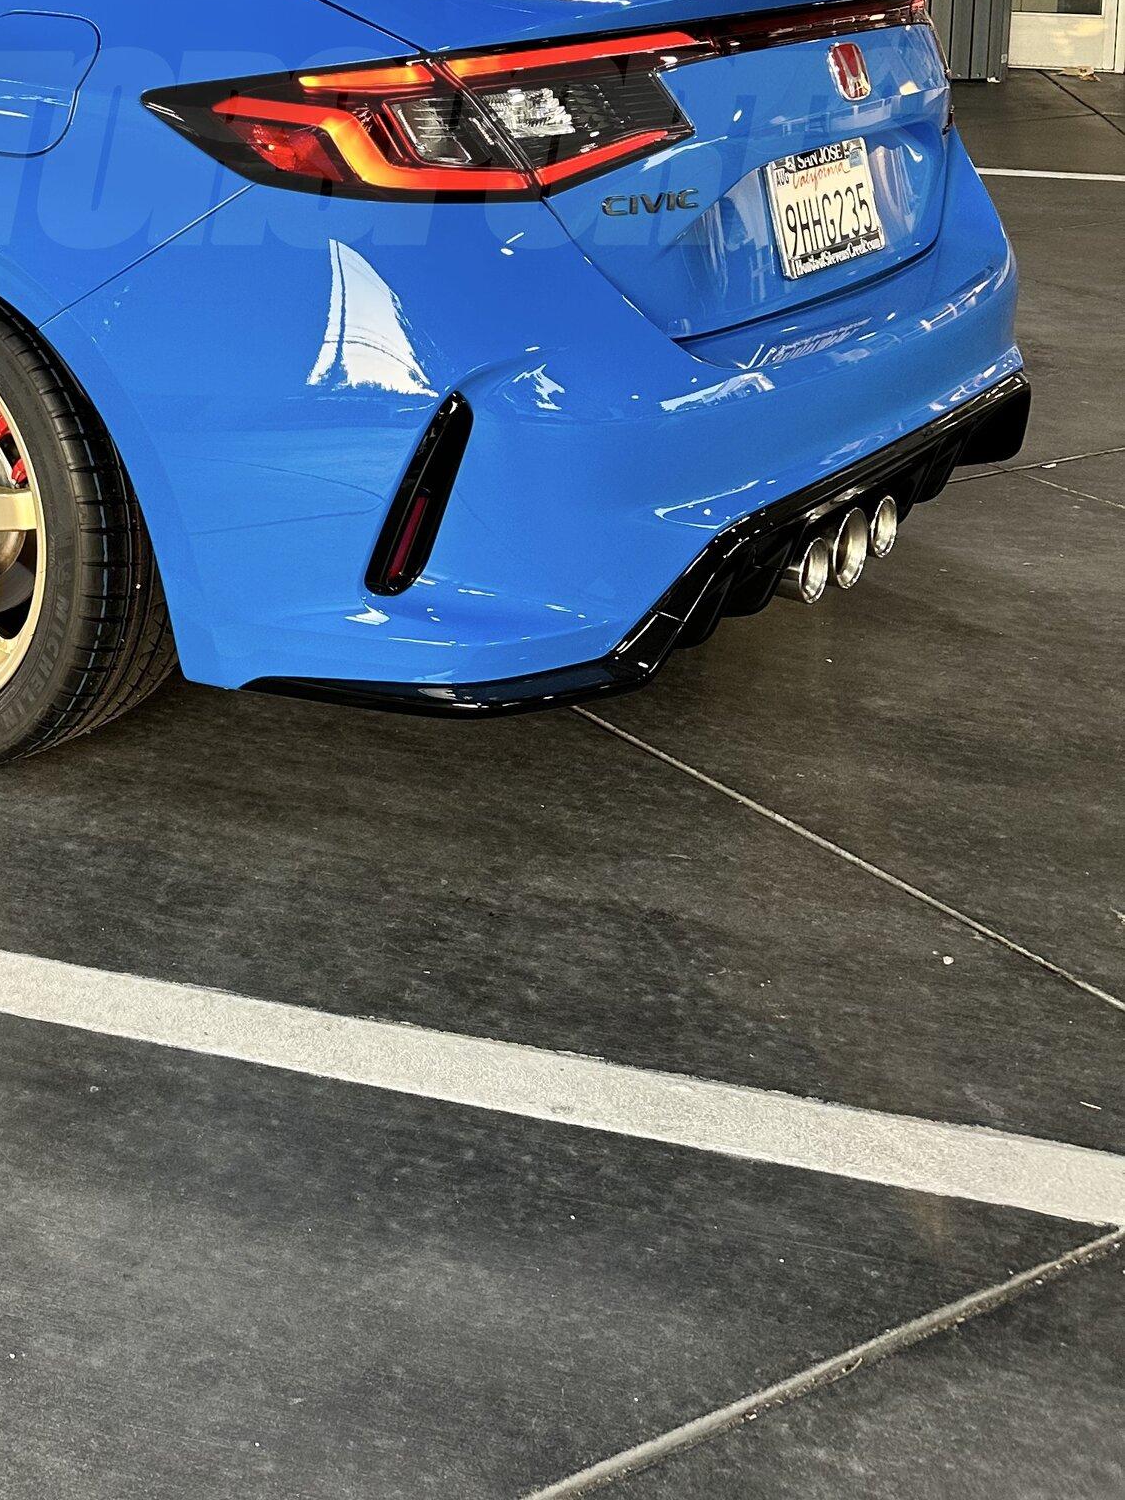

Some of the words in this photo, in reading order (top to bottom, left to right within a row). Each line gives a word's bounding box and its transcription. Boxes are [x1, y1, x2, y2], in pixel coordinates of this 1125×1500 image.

[796, 150, 819, 169] SAN
[819, 144, 843, 164] JOSE
[792, 161, 850, 190] California
[601, 188, 700, 216] CIVIC
[785, 182, 872, 257] 9HHG235
